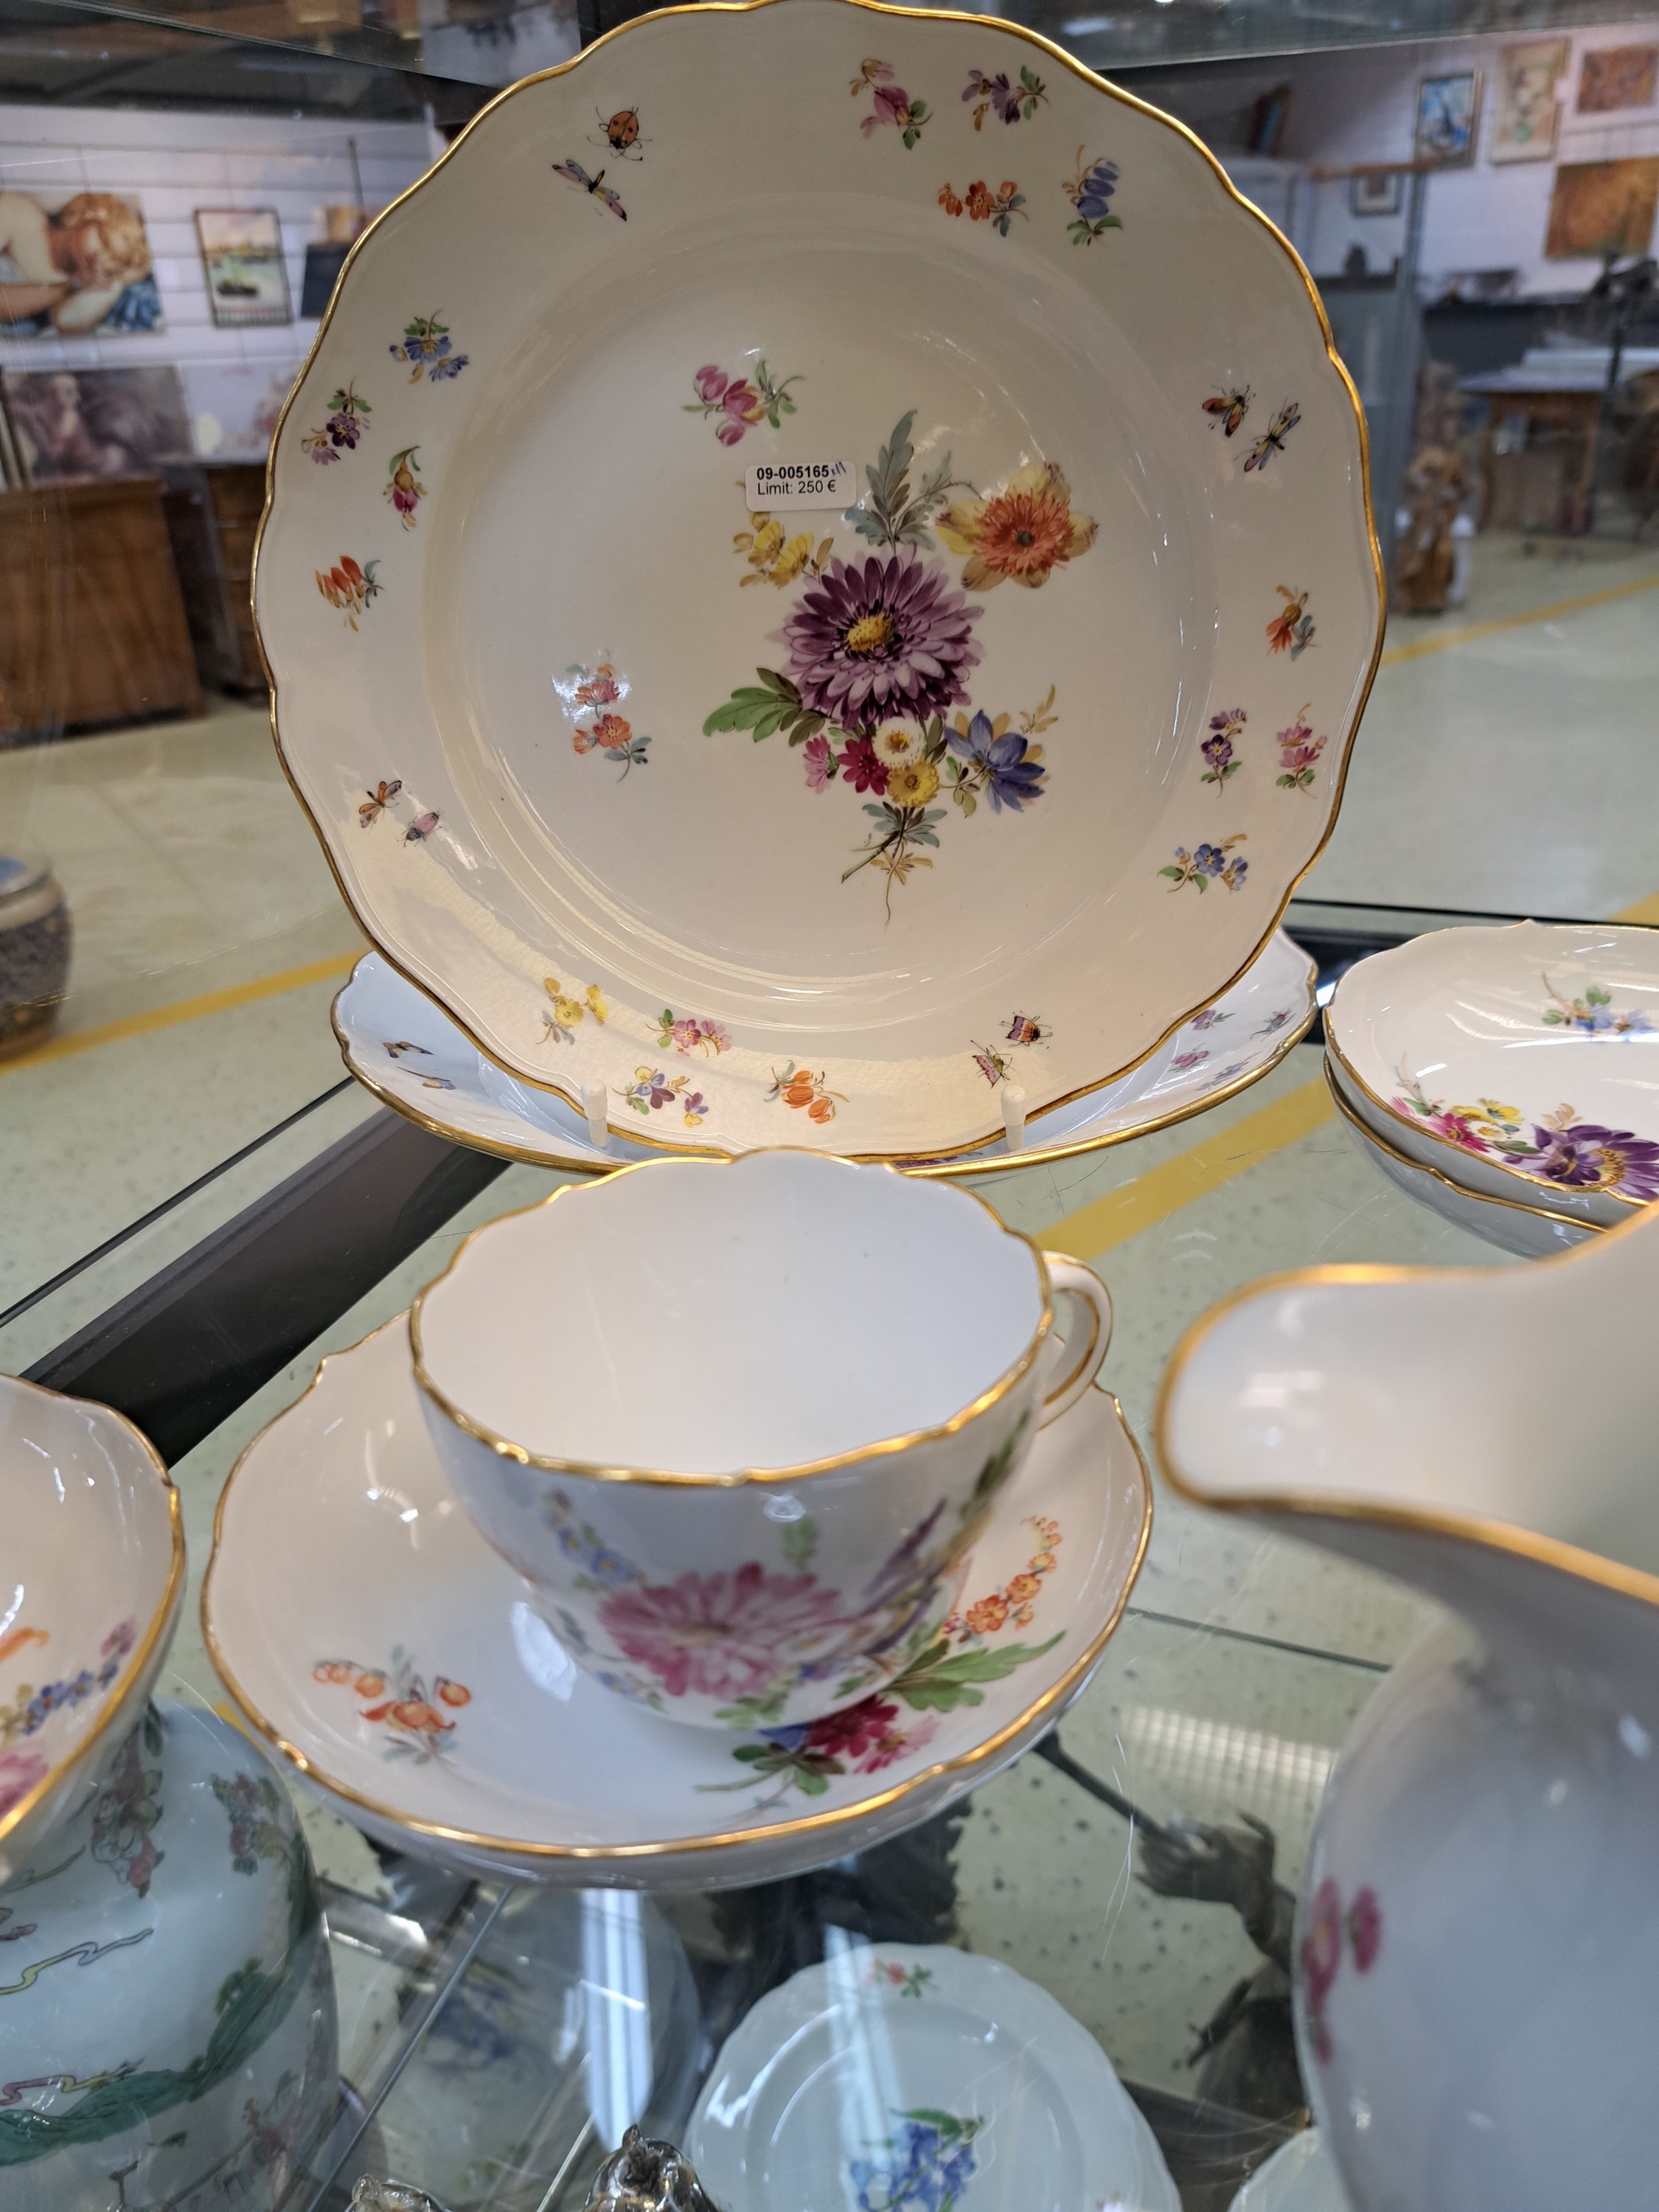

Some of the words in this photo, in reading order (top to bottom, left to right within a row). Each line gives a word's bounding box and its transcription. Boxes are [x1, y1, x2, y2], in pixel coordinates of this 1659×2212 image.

[757, 465, 830, 480] 09-005165
[757, 481, 793, 495] Limit:
[798, 479, 824, 494] 250
[827, 479, 837, 493] €
